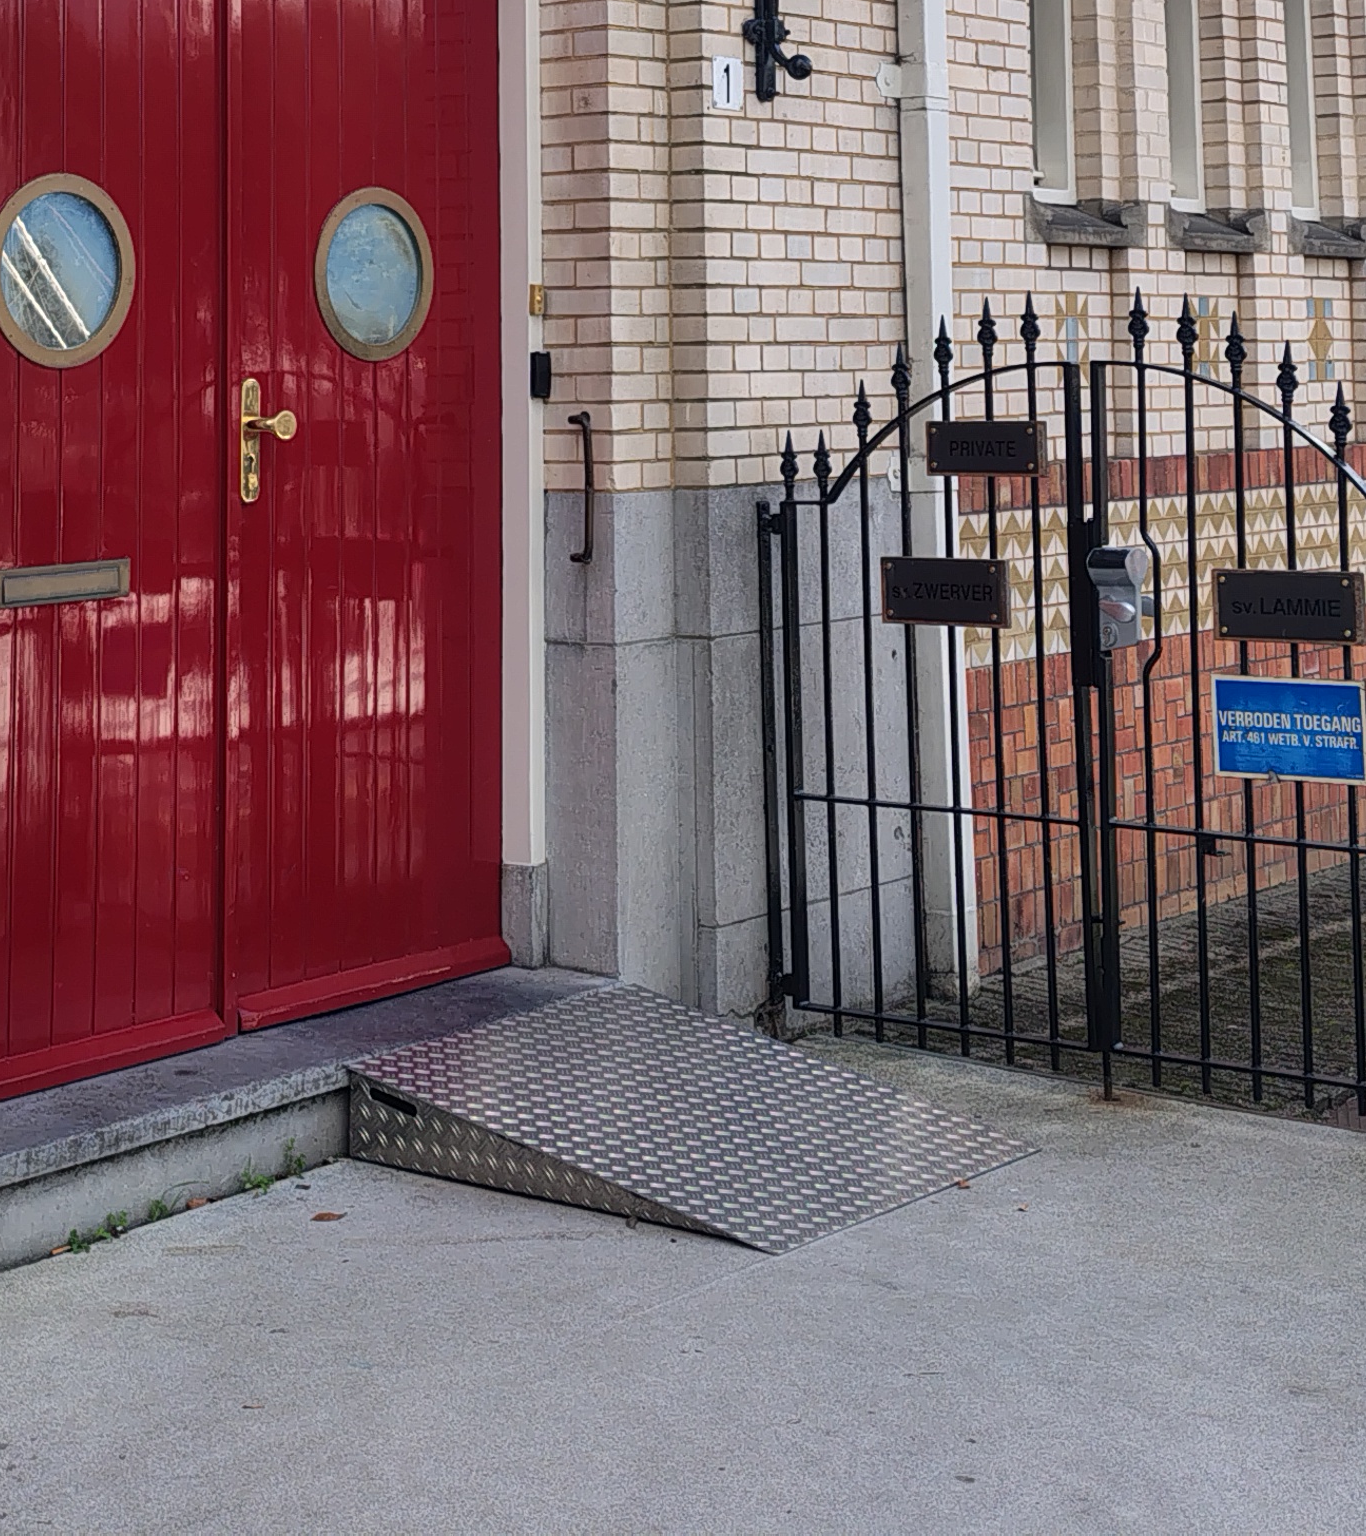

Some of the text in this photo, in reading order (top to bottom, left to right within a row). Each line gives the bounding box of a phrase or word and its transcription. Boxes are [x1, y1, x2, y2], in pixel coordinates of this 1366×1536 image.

[724, 63, 730, 103] 1
[949, 440, 1017, 457] PRIVATE
[913, 582, 993, 601] ZWERVER
[1232, 597, 1341, 617] sv. LAMMIE
[1219, 710, 1361, 733] VERBODEN TOEGANG
[1222, 730, 1245, 743] ART.
[1268, 733, 1301, 747] WETB.
[1303, 735, 1314, 747] V.
